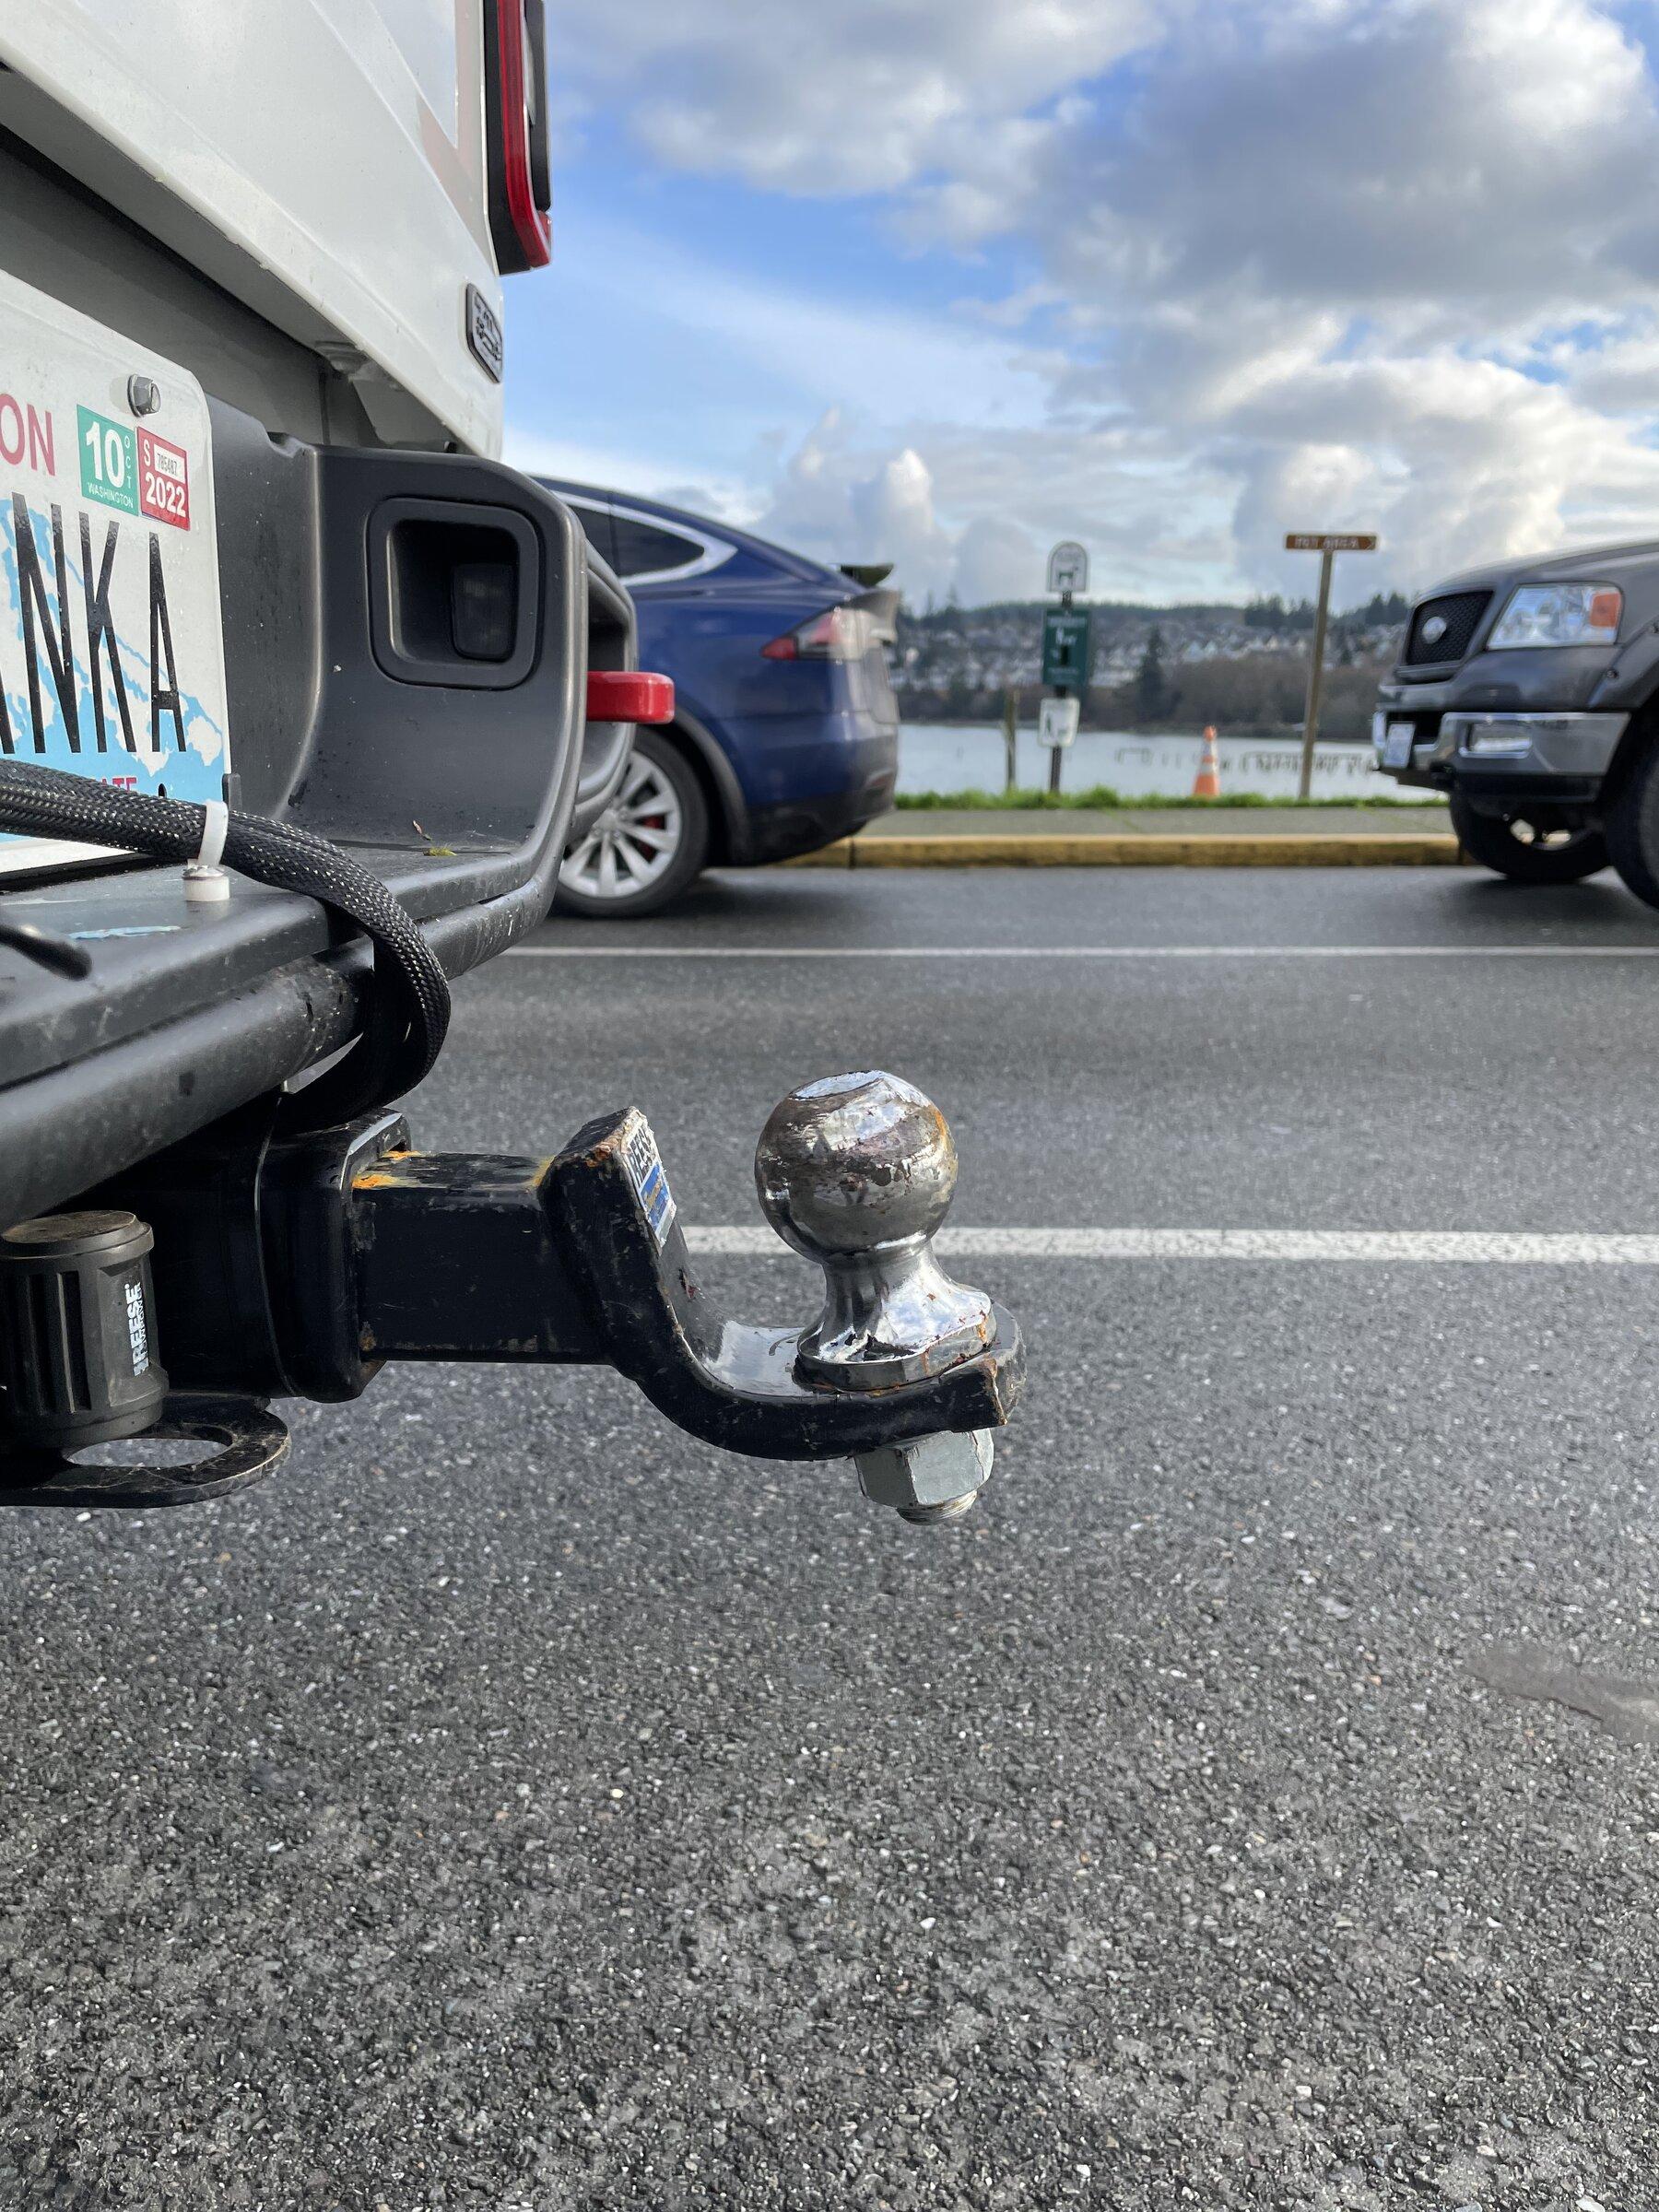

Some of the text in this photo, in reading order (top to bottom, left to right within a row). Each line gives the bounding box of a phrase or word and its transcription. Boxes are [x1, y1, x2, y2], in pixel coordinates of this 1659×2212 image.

[86, 420, 125, 488] 10
[144, 439, 151, 467] S
[88, 481, 134, 509] WASHINGTON
[146, 471, 186, 518] 2022
[0, 492, 186, 754] NKA
